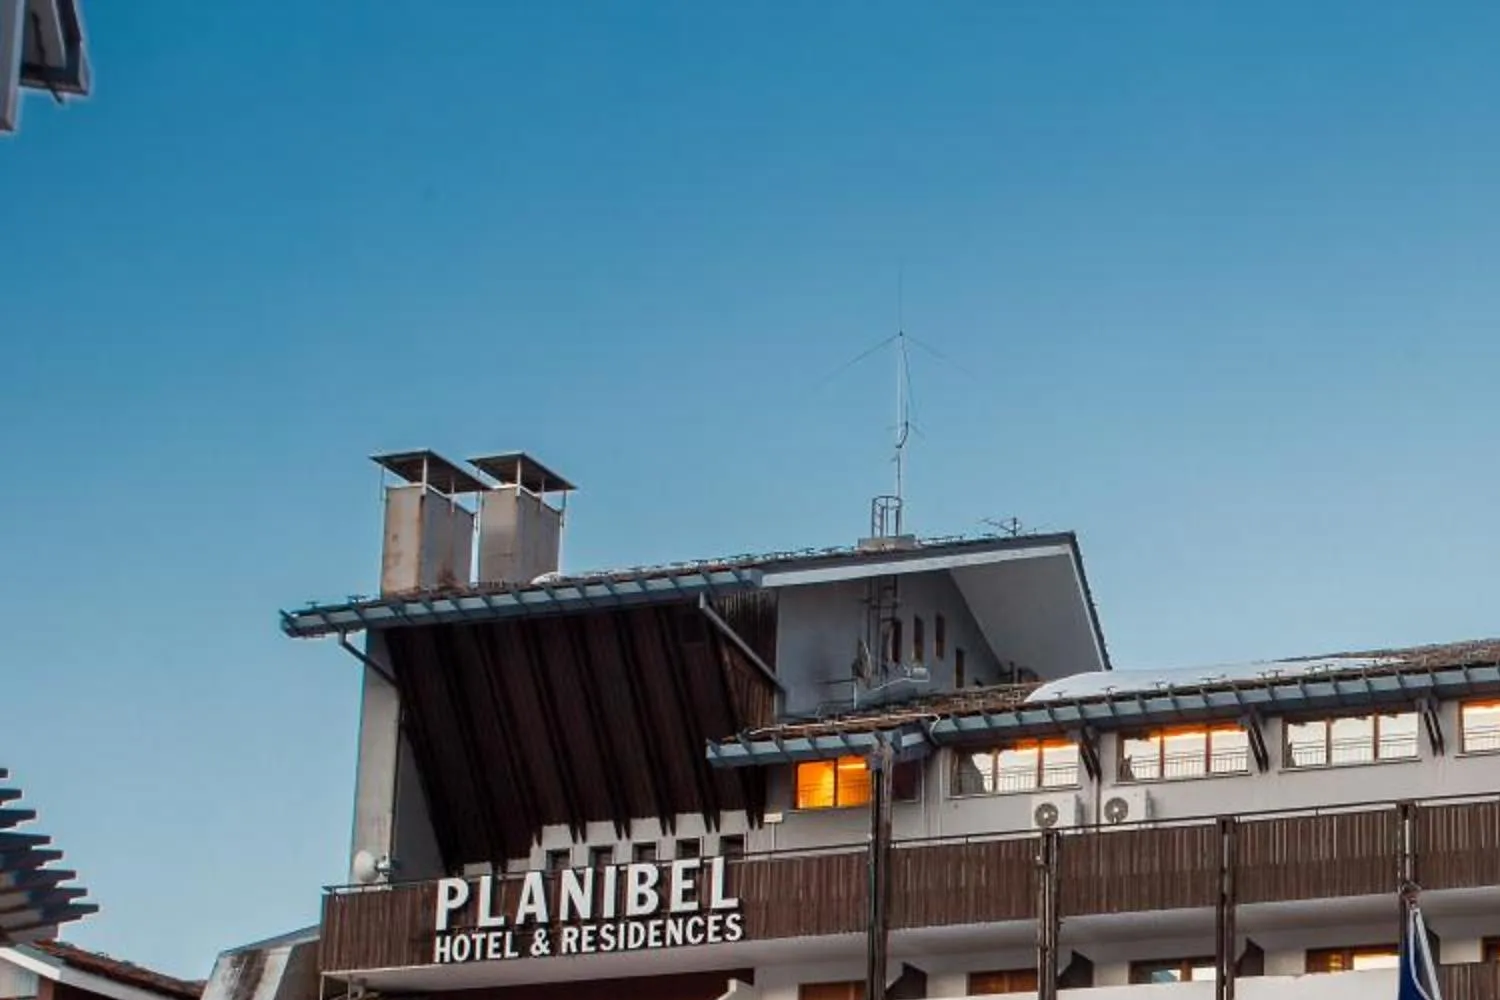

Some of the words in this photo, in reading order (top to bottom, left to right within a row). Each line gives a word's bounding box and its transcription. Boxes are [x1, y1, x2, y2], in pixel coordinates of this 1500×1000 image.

[436, 856, 739, 930] PLANIBEL
[433, 931, 519, 963] HOTEL
[530, 929, 551, 956] &
[561, 914, 743, 954] RESIDENCES
